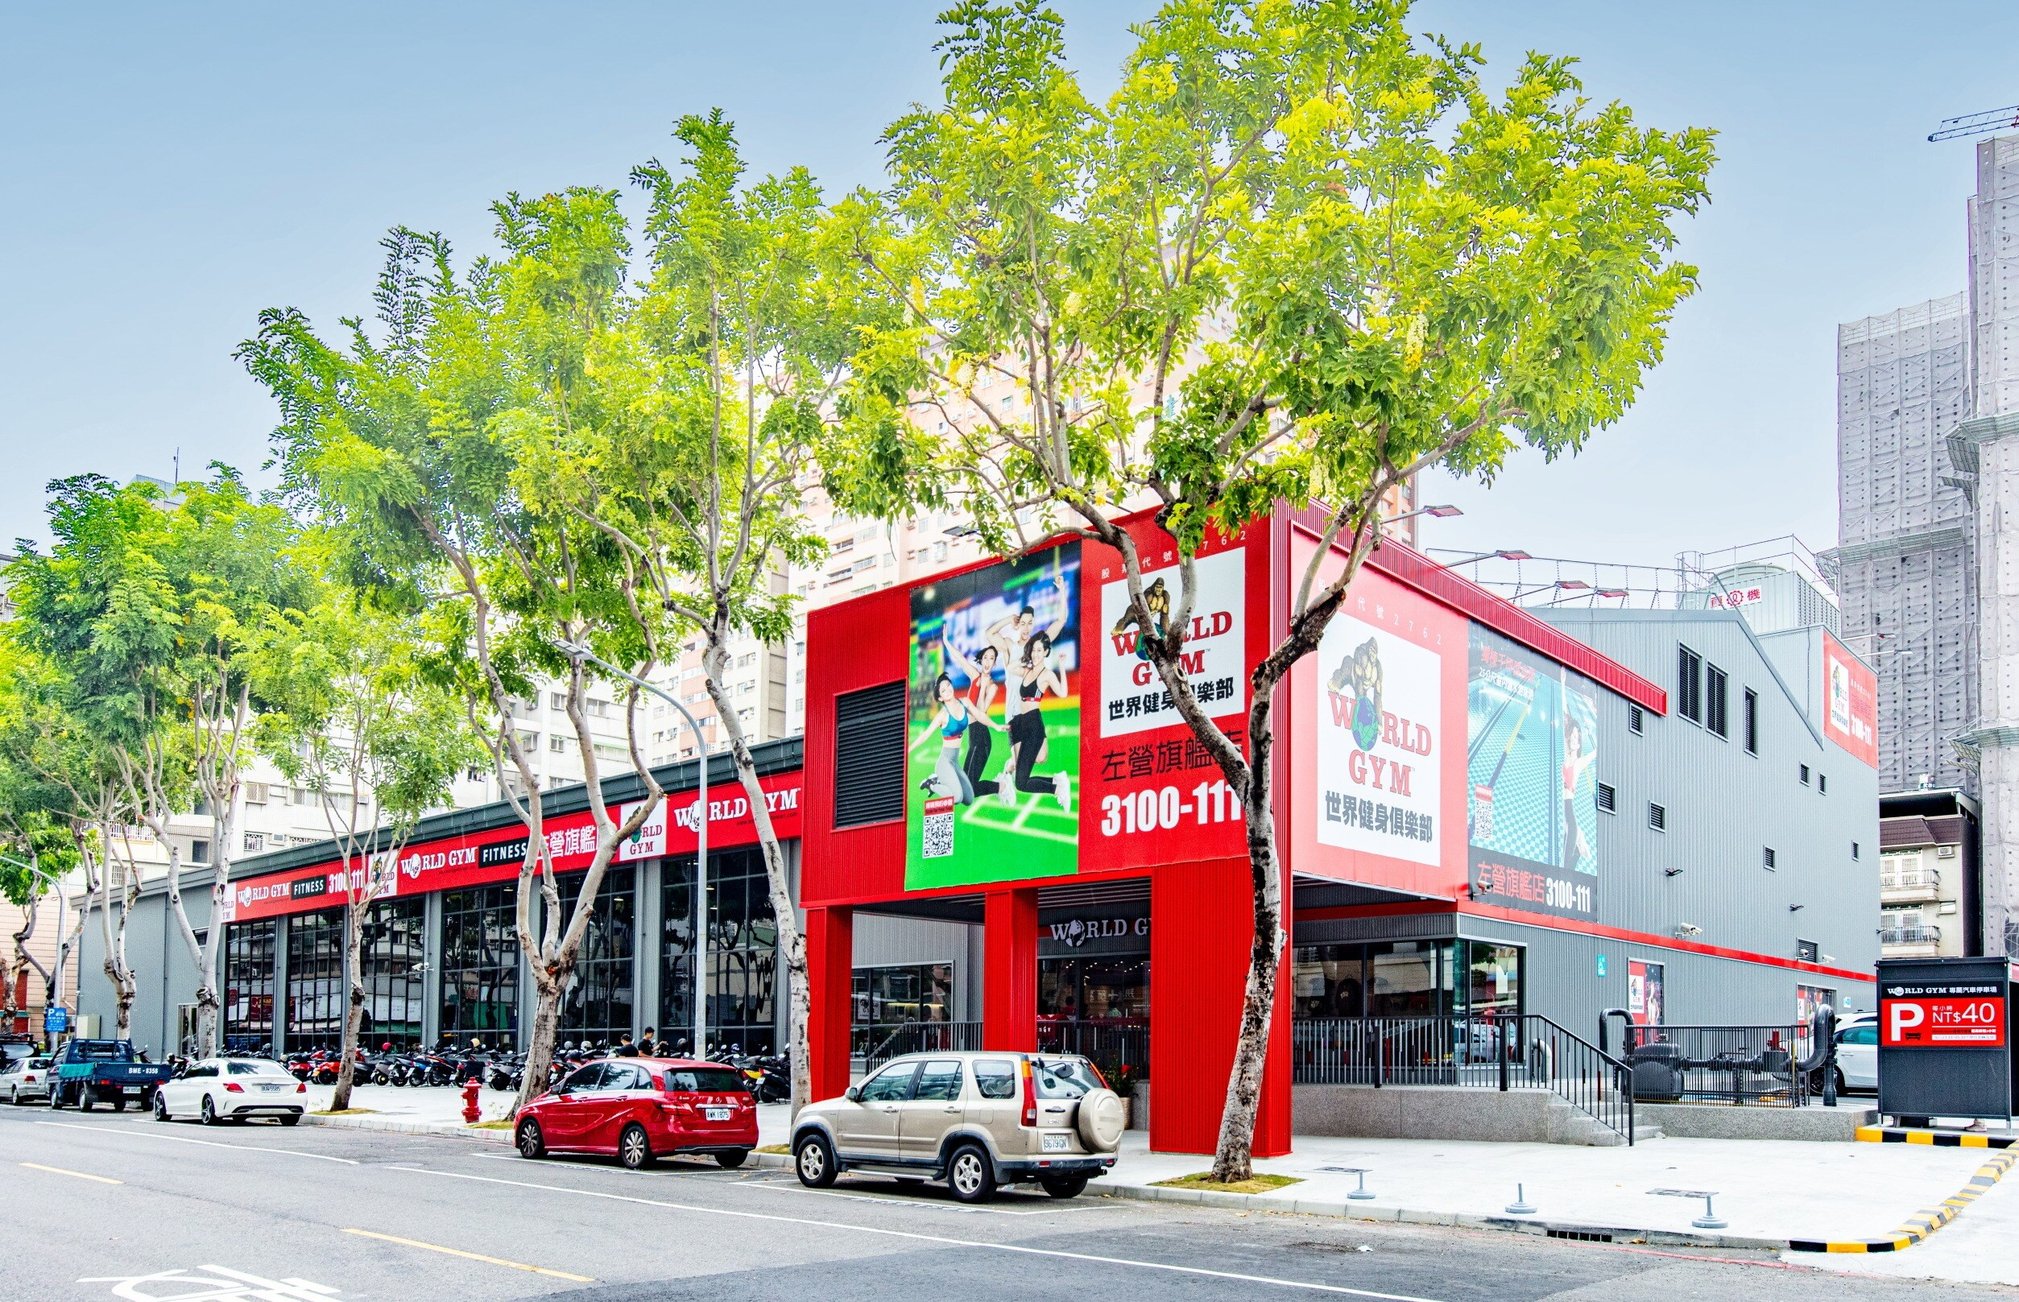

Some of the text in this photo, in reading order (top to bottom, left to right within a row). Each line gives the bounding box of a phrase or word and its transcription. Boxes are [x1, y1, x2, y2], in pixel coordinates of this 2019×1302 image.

[1111, 611, 1232, 660] WOLD
[1132, 649, 1206, 687] GM
[1108, 676, 1234, 722] 世界健身樂部
[1328, 690, 1432, 757] WORLD
[1349, 749, 1411, 798] GYM
[765, 788, 800, 813] YM
[1101, 779, 1242, 837] 3100-111
[1325, 790, 1433, 843] 世界健身俱樂部
[400, 853, 446, 880] WORLD
[448, 846, 478, 867] GYM
[482, 842, 528, 863] FITNESS
[536, 825, 599, 861] 營旗艦
[629, 841, 654, 855] GYM
[237, 886, 269, 907] WORLD
[270, 882, 291, 898] GYM
[293, 879, 325, 895] FITNESS
[1477, 861, 1545, 904] 左營旗艦店
[1546, 877, 1591, 913] 3100-111
[1049, 919, 1128, 947] WORLD
[1886, 986, 1924, 997] WORLD
[1890, 1003, 1925, 1042] P
